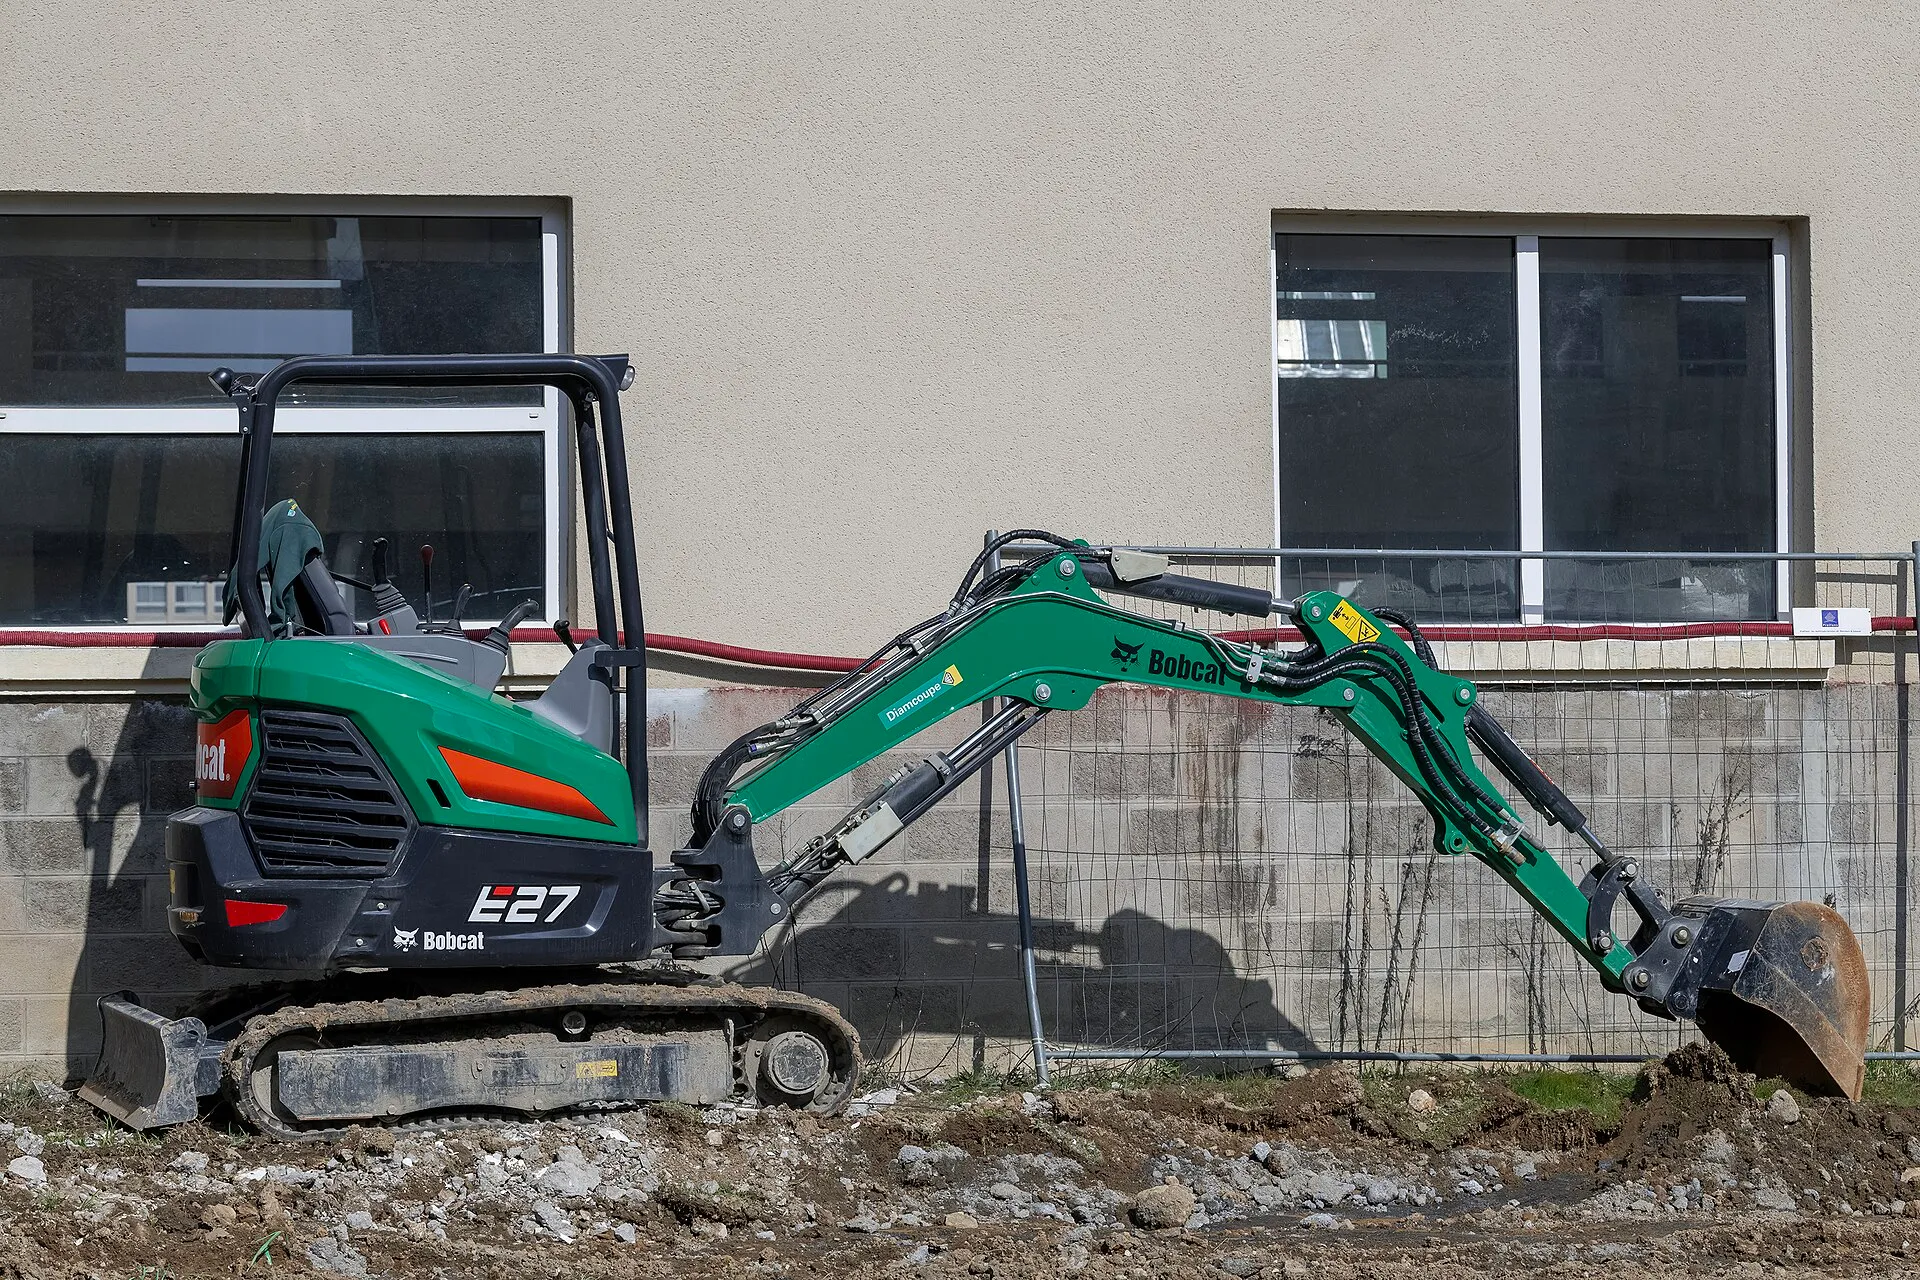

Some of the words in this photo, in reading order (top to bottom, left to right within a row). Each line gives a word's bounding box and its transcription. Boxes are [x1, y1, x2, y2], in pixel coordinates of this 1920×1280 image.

[1149, 649, 1226, 686] Bobcat
[886, 683, 941, 722] Diamcoupe
[196, 735, 226, 782] bcat
[467, 885, 581, 923] E27
[423, 931, 485, 951] Bobcat
